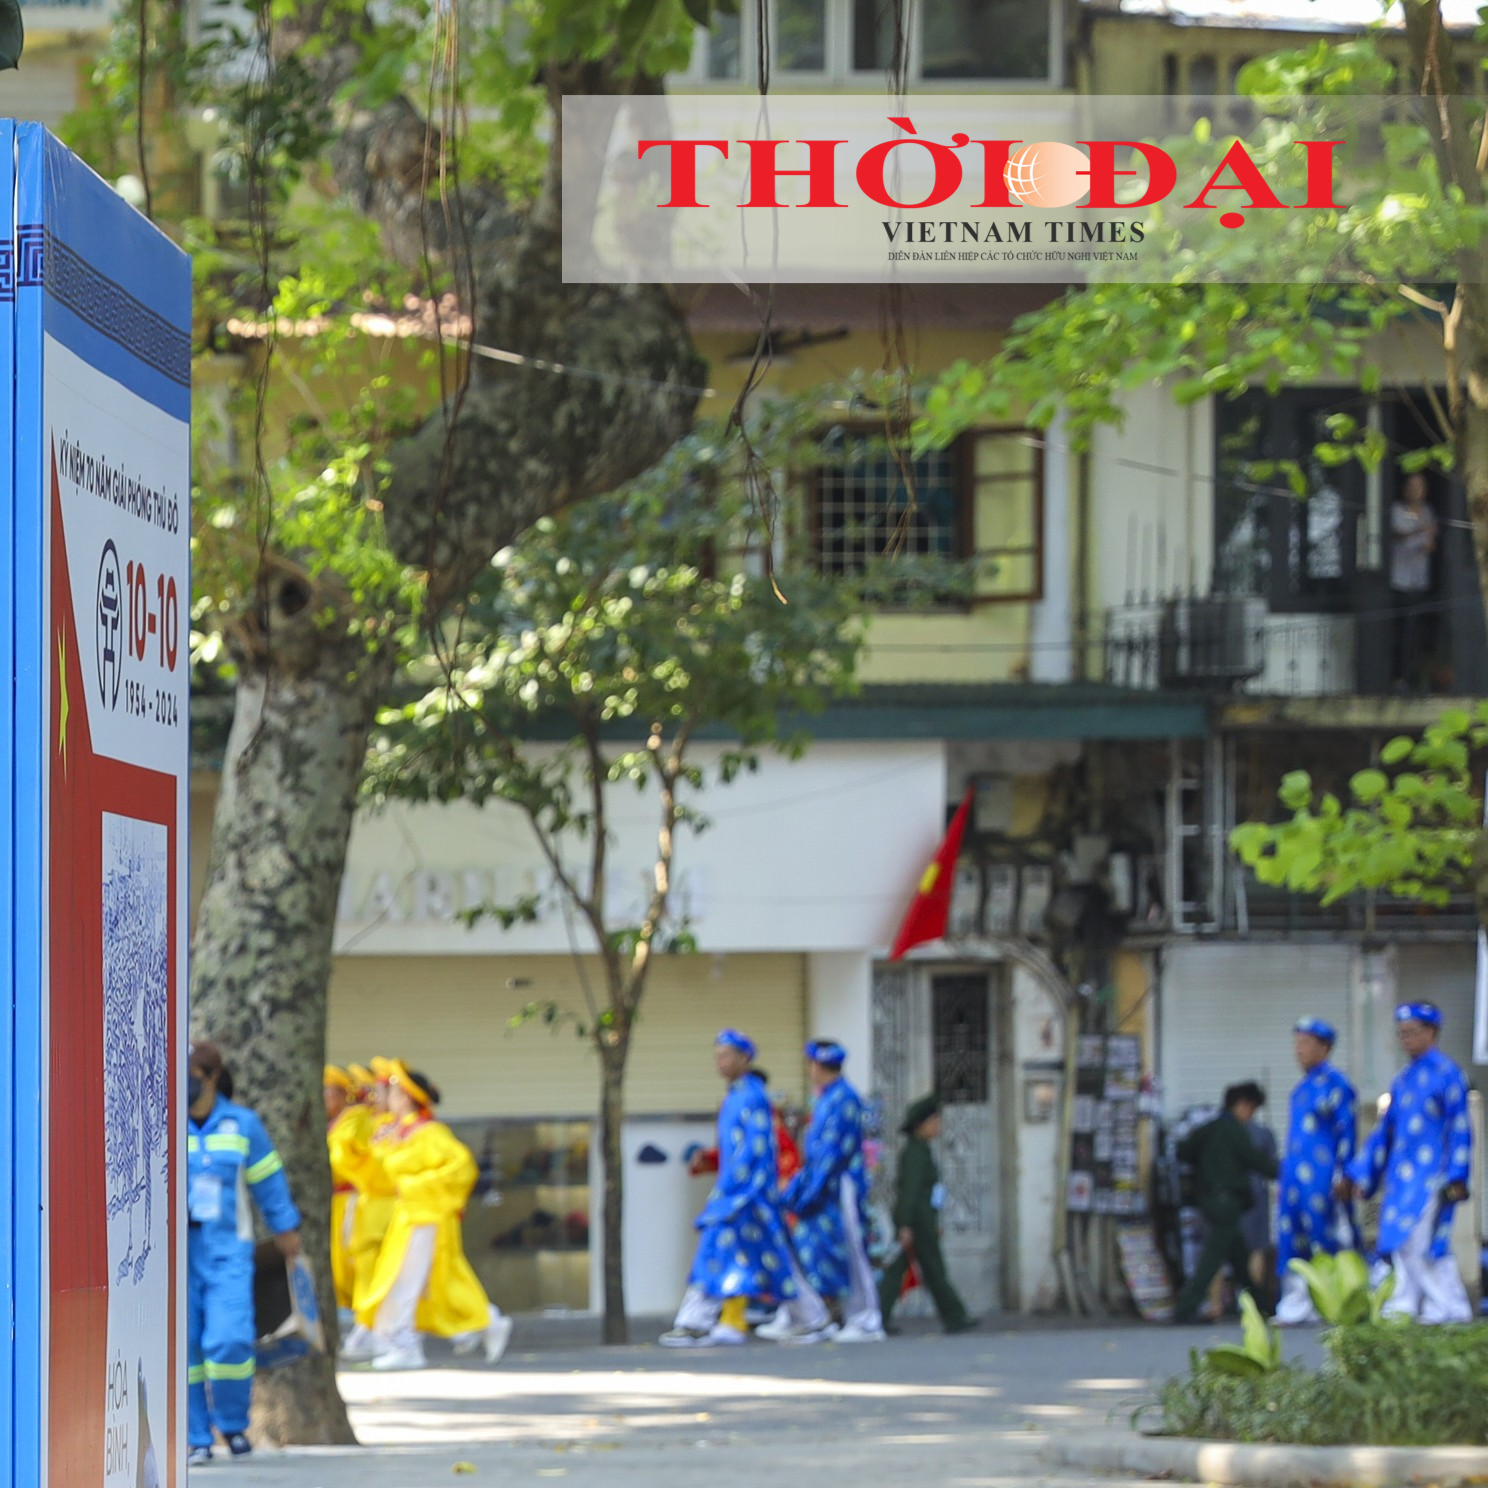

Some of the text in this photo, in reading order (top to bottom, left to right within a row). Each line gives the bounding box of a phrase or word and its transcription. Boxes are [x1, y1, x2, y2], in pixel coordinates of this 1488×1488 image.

[69, 439, 85, 496] NIỆM
[86, 454, 95, 494] 70
[95, 454, 112, 502] NĂM
[112, 462, 126, 510] GIẢI
[127, 474, 152, 523] PHÓNG
[153, 485, 166, 530] THỦ
[167, 492, 179, 535] ĐÔ
[126, 558, 178, 673] 10-10
[124, 678, 146, 721] 1954
[155, 687, 179, 728] 2024
[107, 1348, 129, 1412] HÒA
